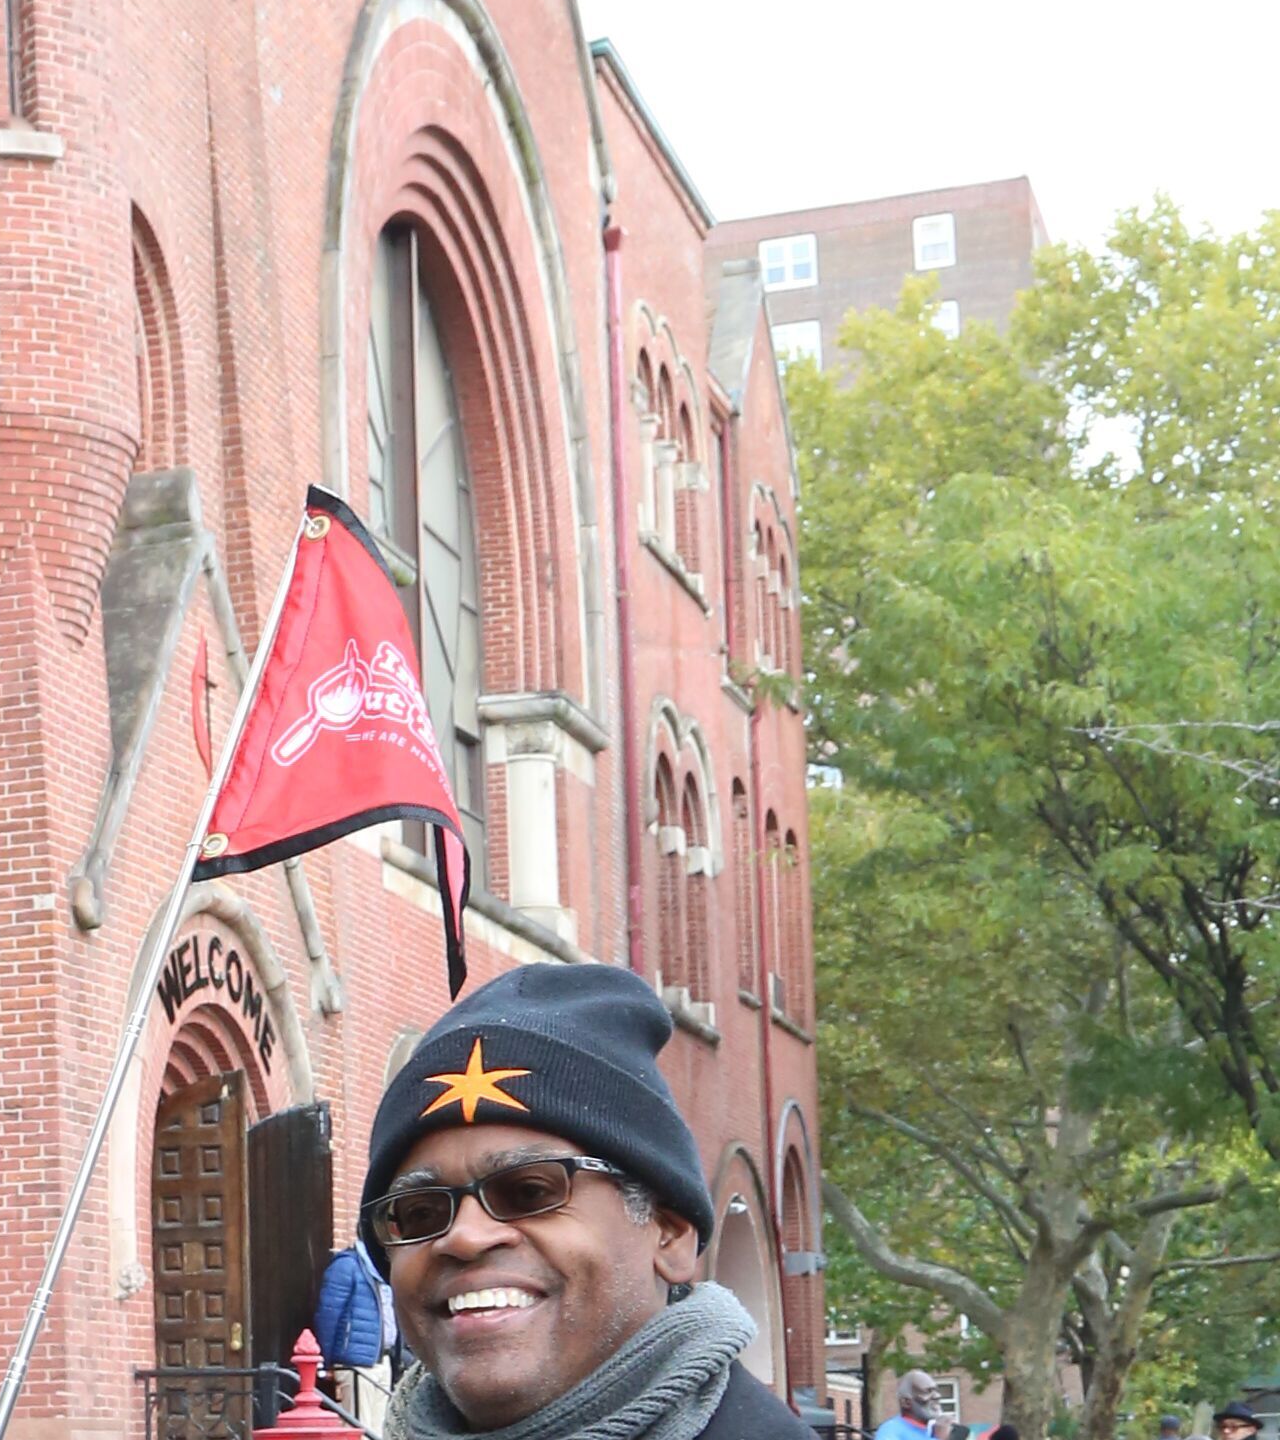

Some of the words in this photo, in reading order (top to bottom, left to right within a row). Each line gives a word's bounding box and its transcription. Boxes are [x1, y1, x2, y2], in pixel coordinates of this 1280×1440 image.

[378, 730, 408, 748] ARE
[409, 745, 438, 773] NEW
[156, 934, 276, 1077] WELCOME
